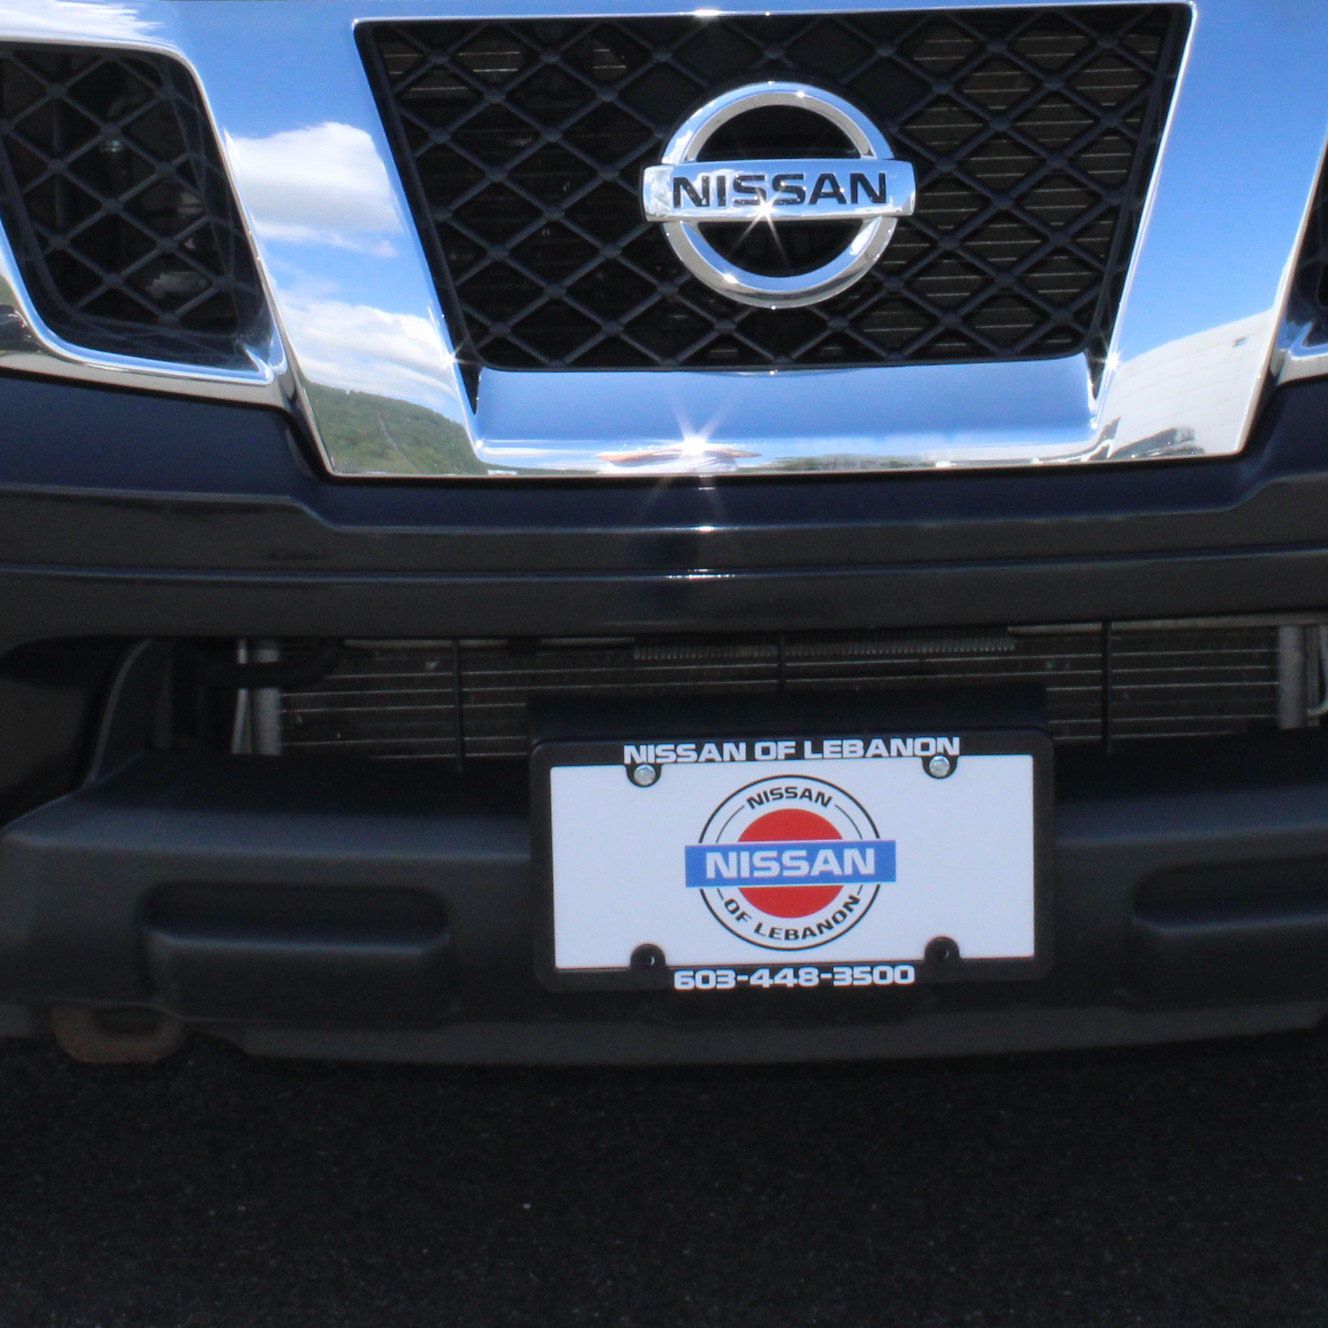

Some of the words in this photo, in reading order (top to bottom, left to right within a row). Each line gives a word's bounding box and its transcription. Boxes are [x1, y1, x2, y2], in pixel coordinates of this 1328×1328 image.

[673, 172, 886, 208] NISSAN
[623, 742, 746, 764] NISSAN
[755, 740, 796, 760] OF
[804, 736, 960, 759] LEBANON
[746, 786, 832, 809] NISSAN
[705, 847, 875, 879] NISSAN
[724, 898, 751, 923] OF
[753, 894, 860, 941] LEBANON
[673, 965, 915, 990] 603-448-3500
